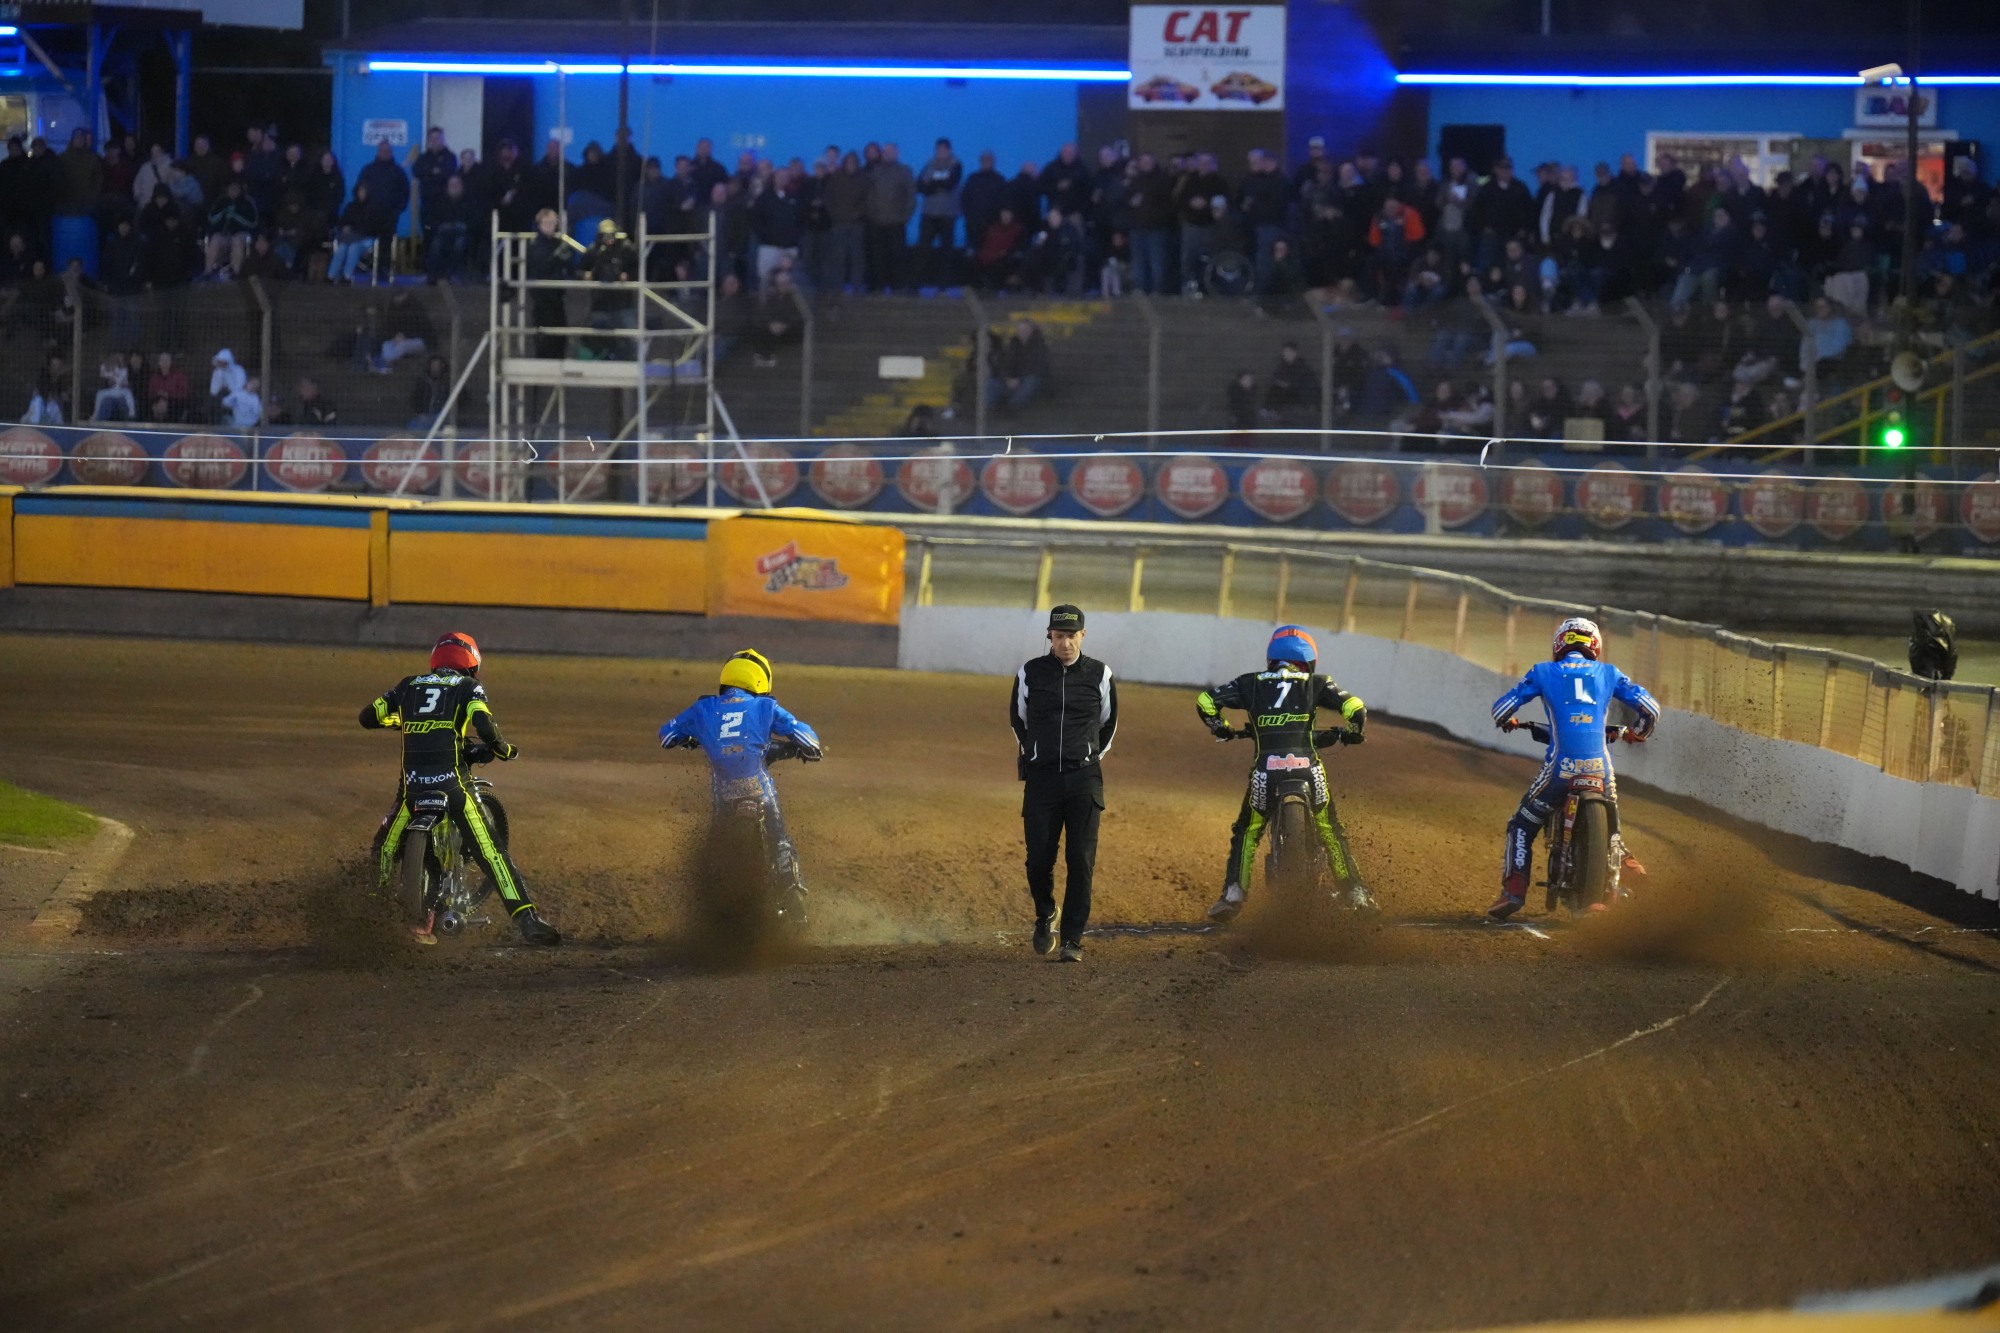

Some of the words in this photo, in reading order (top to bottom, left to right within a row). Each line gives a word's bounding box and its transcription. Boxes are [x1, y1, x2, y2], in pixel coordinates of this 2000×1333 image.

[1163, 10, 1252, 44] CAT
[419, 688, 441, 713] 3
[1274, 682, 1292, 708] 7
[720, 712, 743, 738] 2
[418, 771, 456, 784] TEXOM
[1572, 778, 1601, 788] FRICKE
